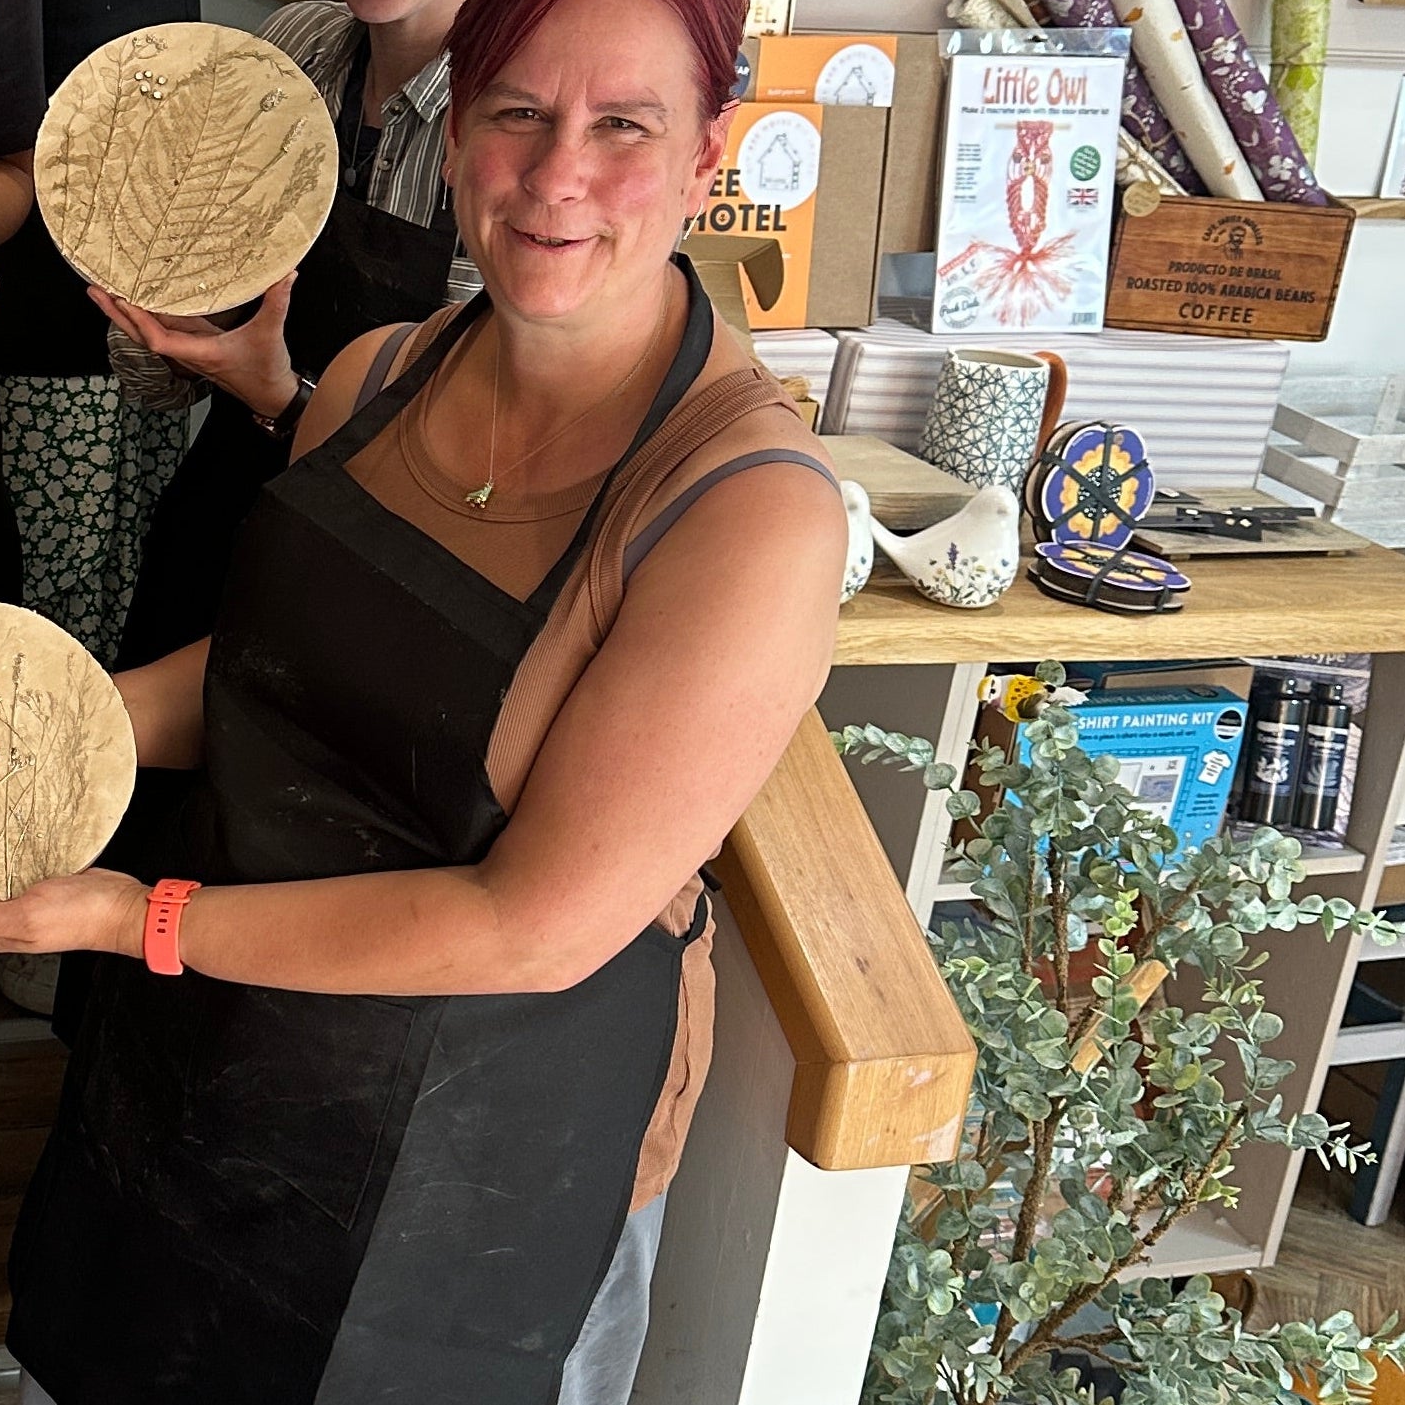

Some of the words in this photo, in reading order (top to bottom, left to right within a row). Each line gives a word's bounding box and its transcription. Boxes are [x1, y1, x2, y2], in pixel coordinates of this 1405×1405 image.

[983, 67, 1040, 105] Little
[1046, 67, 1088, 106] Owl
[1168, 261, 1227, 276] PRODUCTO
[1229, 265, 1244, 278] DE
[1126, 276, 1182, 293] ROASTED
[1185, 280, 1216, 296] 100%
[1220, 283, 1272, 301] ARABICA
[1275, 287, 1316, 304] BEANS
[1178, 301, 1256, 324] COFFEE
[1122, 713, 1189, 728] PAINTING
[1191, 711, 1215, 725] KIT
